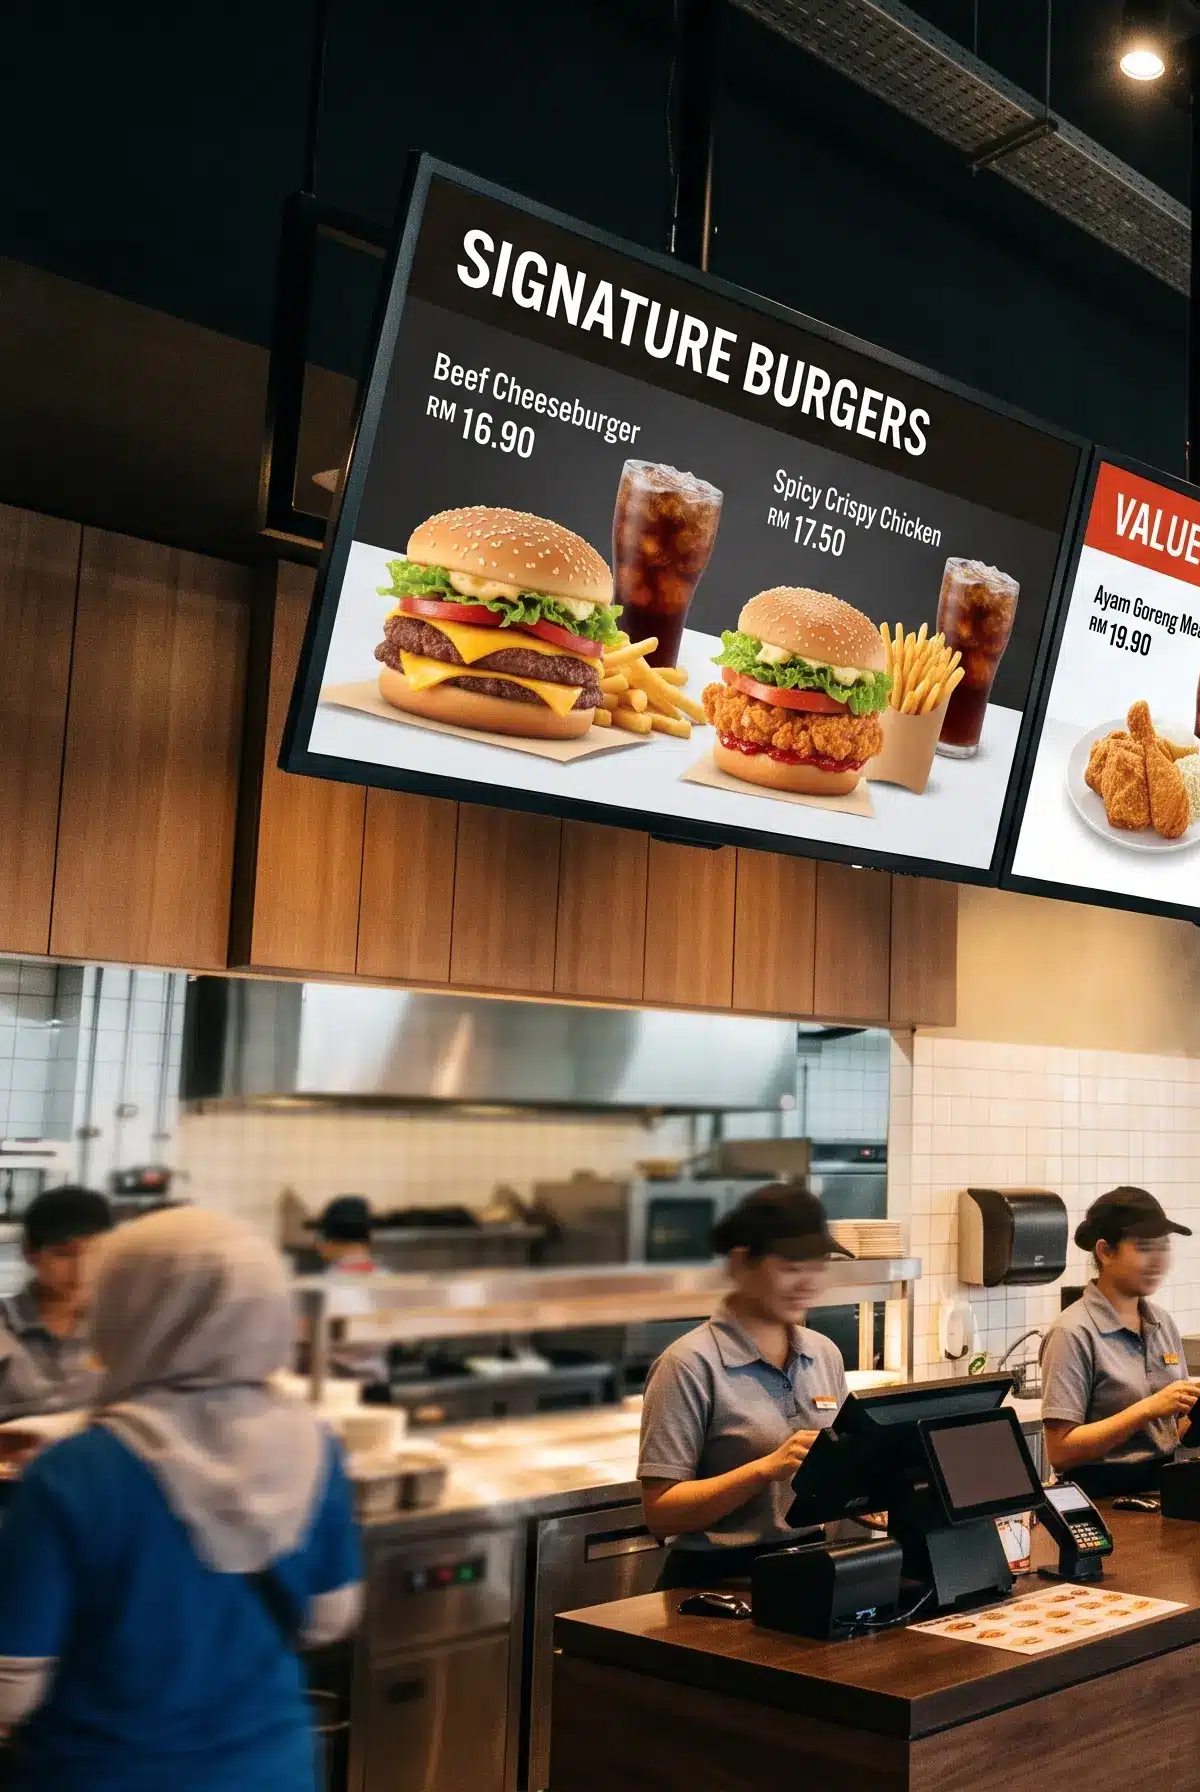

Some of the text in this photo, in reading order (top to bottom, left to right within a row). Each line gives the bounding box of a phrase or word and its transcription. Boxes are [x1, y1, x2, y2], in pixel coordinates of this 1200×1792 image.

[456, 229, 931, 457] SIGNATURE BURGERS
[426, 395, 535, 459] RM 16.90
[433, 353, 641, 444] Beef Cheeseburger
[767, 507, 846, 557] RM 17.50
[773, 469, 942, 547] Spicy Crispy Chicken
[1089, 616, 1151, 656] RM 19.90
[1094, 585, 1131, 615] Ayam
[1133, 598, 1178, 635] Goreng
